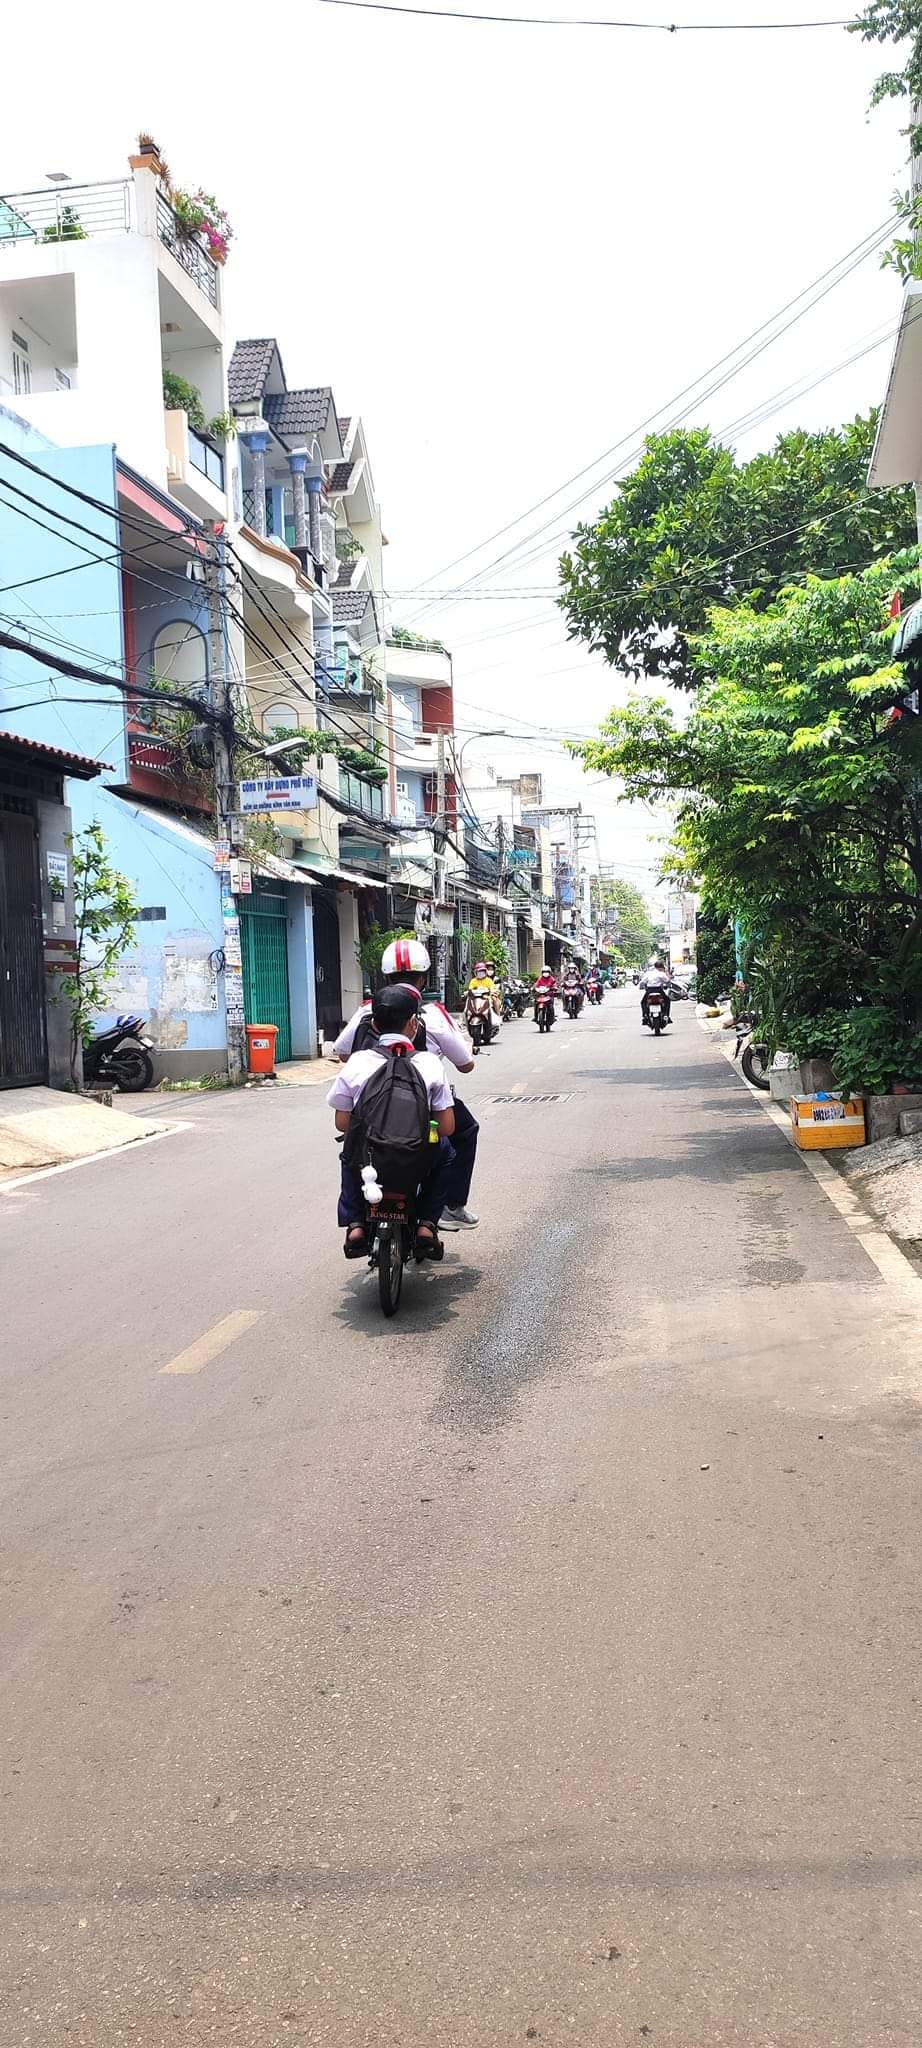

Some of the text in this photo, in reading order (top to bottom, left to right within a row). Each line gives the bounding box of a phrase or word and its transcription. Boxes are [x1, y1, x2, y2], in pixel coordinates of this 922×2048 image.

[243, 782, 256, 792] CÔNG
[257, 782, 263, 792] TY
[264, 780, 274, 790] XÂY
[371, 1207, 405, 1220] KING STAR
